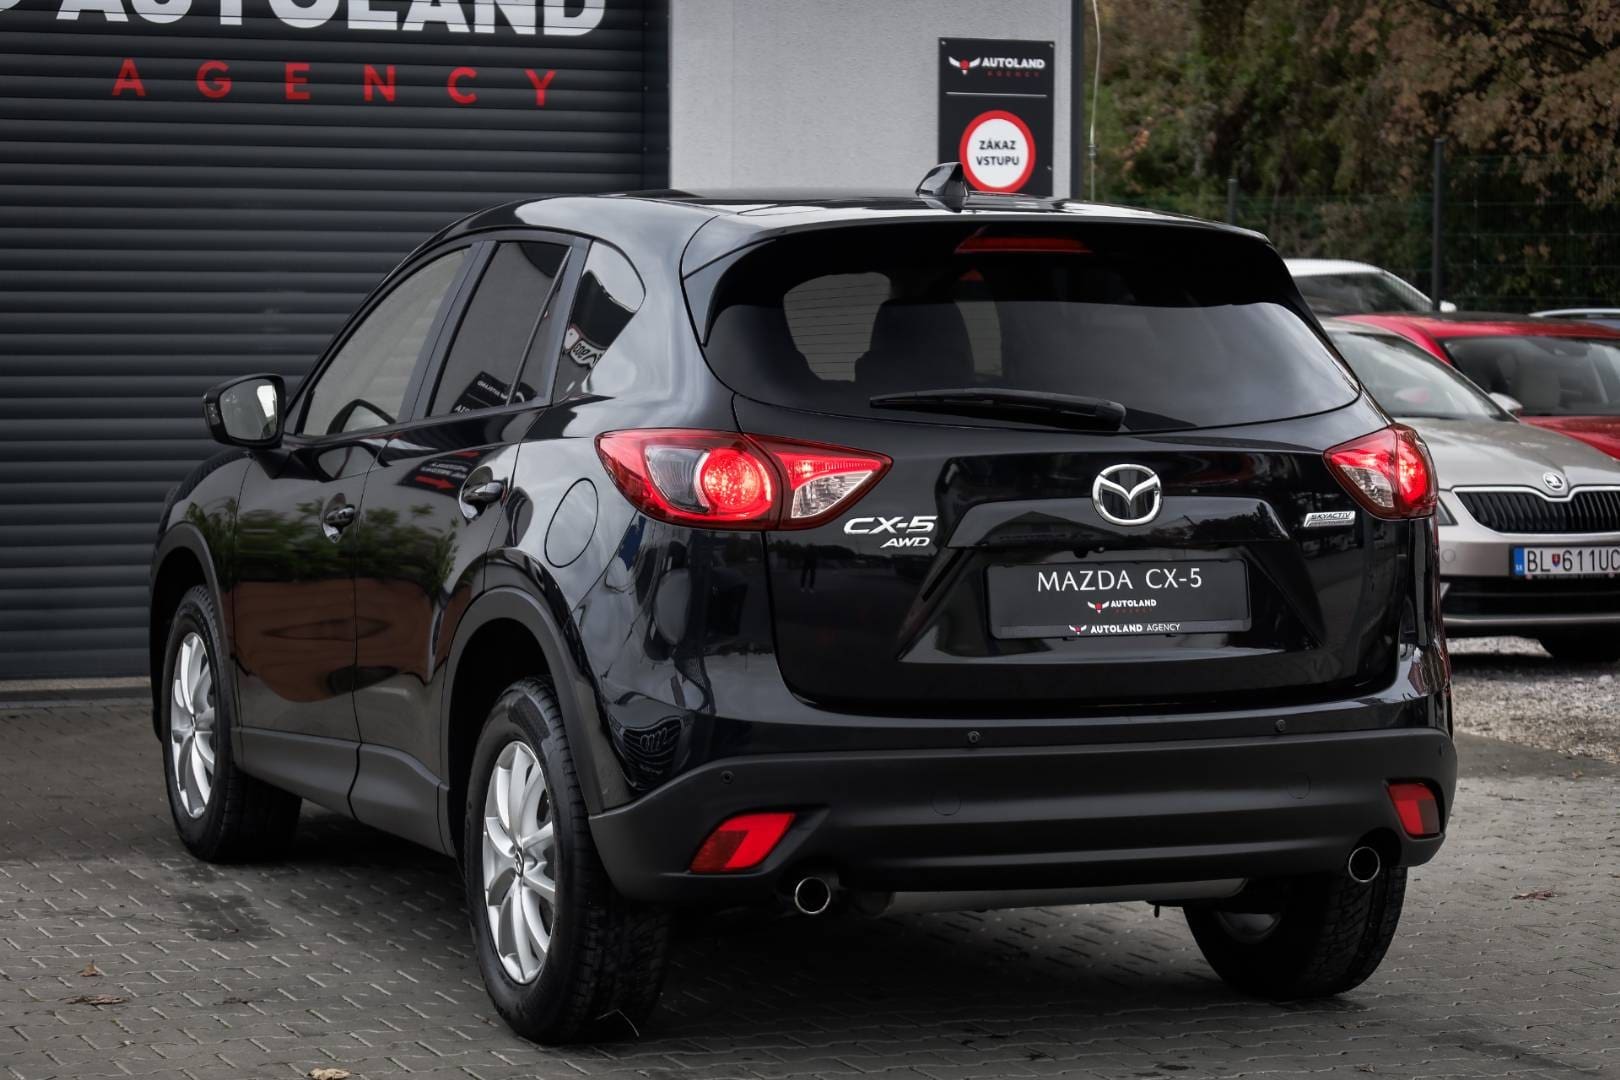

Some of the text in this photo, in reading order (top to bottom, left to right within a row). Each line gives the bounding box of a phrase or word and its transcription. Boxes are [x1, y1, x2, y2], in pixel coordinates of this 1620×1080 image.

[981, 57, 1046, 69] AUTOLAND
[110, 58, 558, 106] AGENCY
[979, 138, 1017, 150] ZÁKAZ
[976, 156, 1020, 166] VSTUPU
[1311, 512, 1352, 520] SKYACTIV
[843, 515, 938, 535] CX-5
[880, 537, 931, 549] AWD
[1527, 550, 1551, 572] BL
[1037, 568, 1203, 592] MAZDA CX-5
[1110, 599, 1157, 608] AUTOLAND
[1090, 623, 1181, 634] AUTOLAND AGENCY
